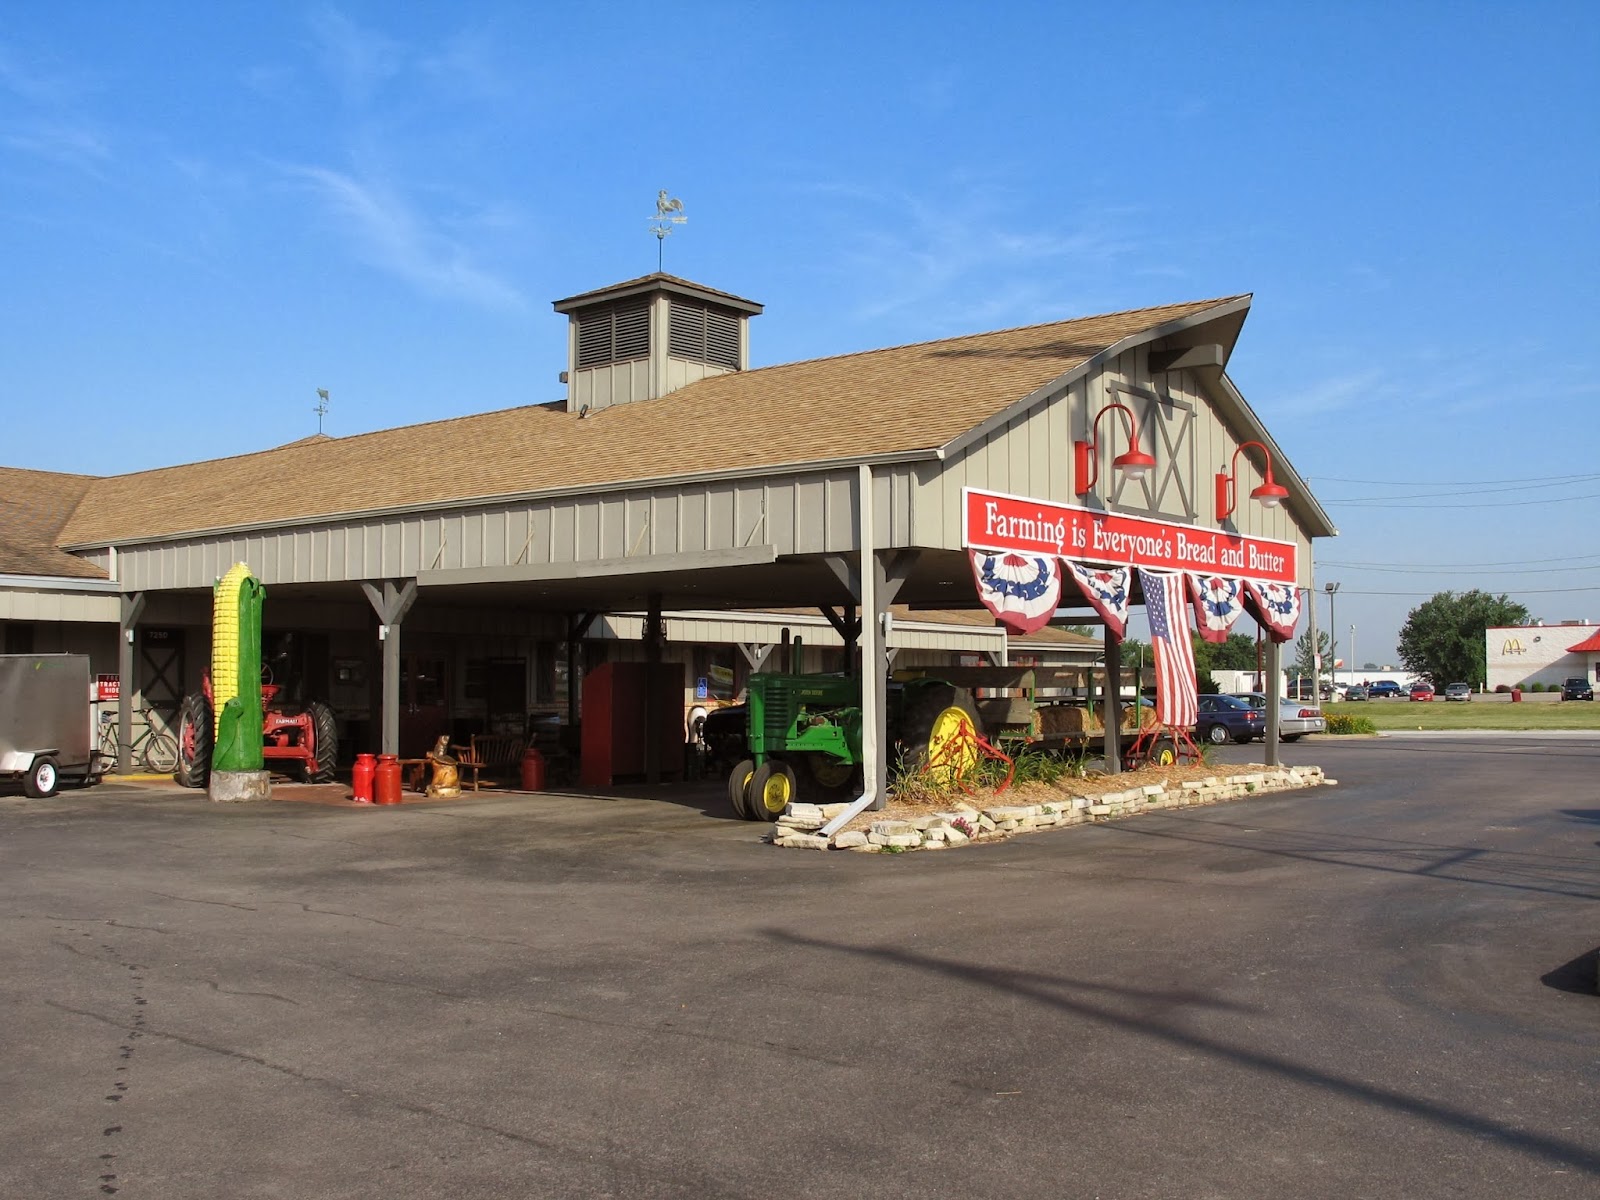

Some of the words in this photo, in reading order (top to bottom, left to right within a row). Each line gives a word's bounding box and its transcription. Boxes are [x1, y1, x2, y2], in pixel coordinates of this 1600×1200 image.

[985, 501, 1066, 554] Farming
[1071, 518, 1086, 549] is
[1092, 520, 1172, 562] Everyone's
[1176, 532, 1216, 564] Bread
[1220, 541, 1245, 568] and
[1248, 543, 1285, 573] Butter
[149, 631, 168, 639] 7250
